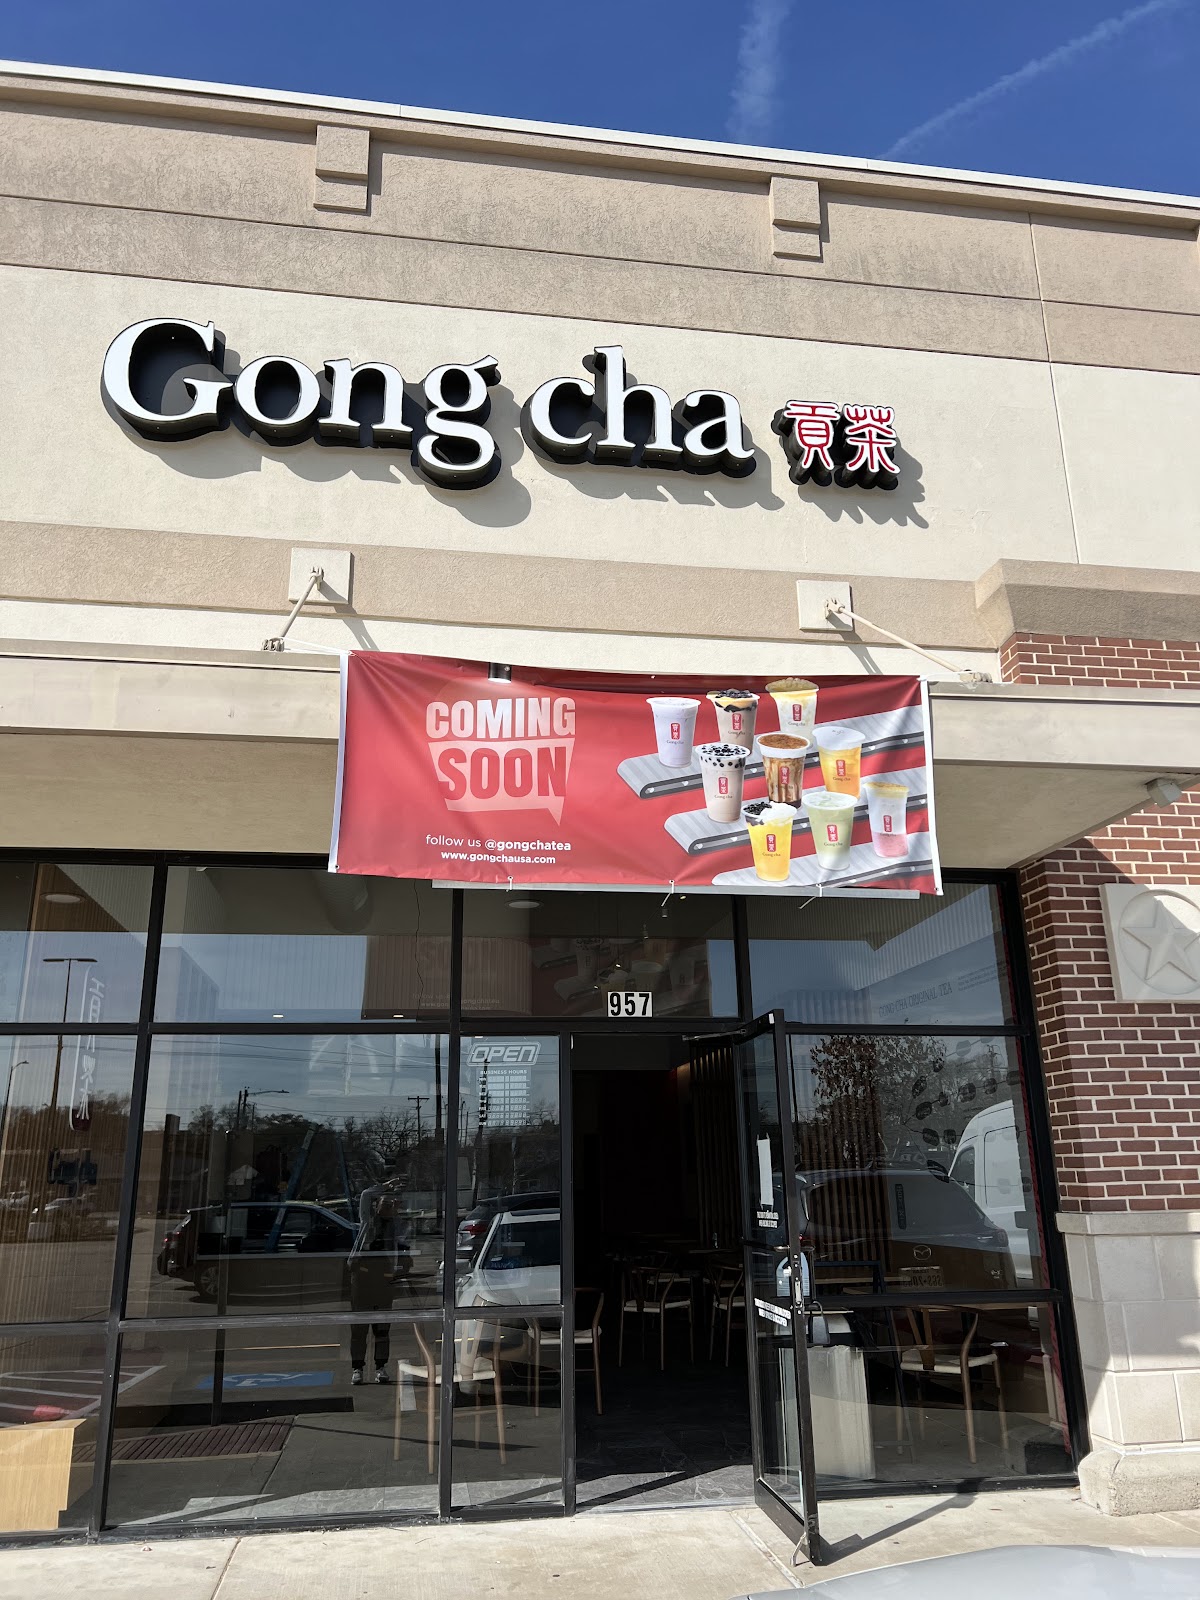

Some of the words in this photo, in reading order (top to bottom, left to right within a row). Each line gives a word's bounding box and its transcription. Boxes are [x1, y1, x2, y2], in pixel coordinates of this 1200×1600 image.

[102, 318, 498, 474] Gong
[528, 345, 756, 462] cha
[783, 400, 901, 475] 貢茶
[425, 697, 576, 739] COMING
[438, 746, 567, 801] SOON
[426, 834, 464, 847] follow
[467, 839, 482, 848] us
[484, 839, 572, 852] @gongchatea
[441, 851, 556, 864] www.gongchausa.com
[937, 981, 953, 997] TEA
[609, 992, 650, 1016] 957
[472, 1046, 535, 1062] OPEN
